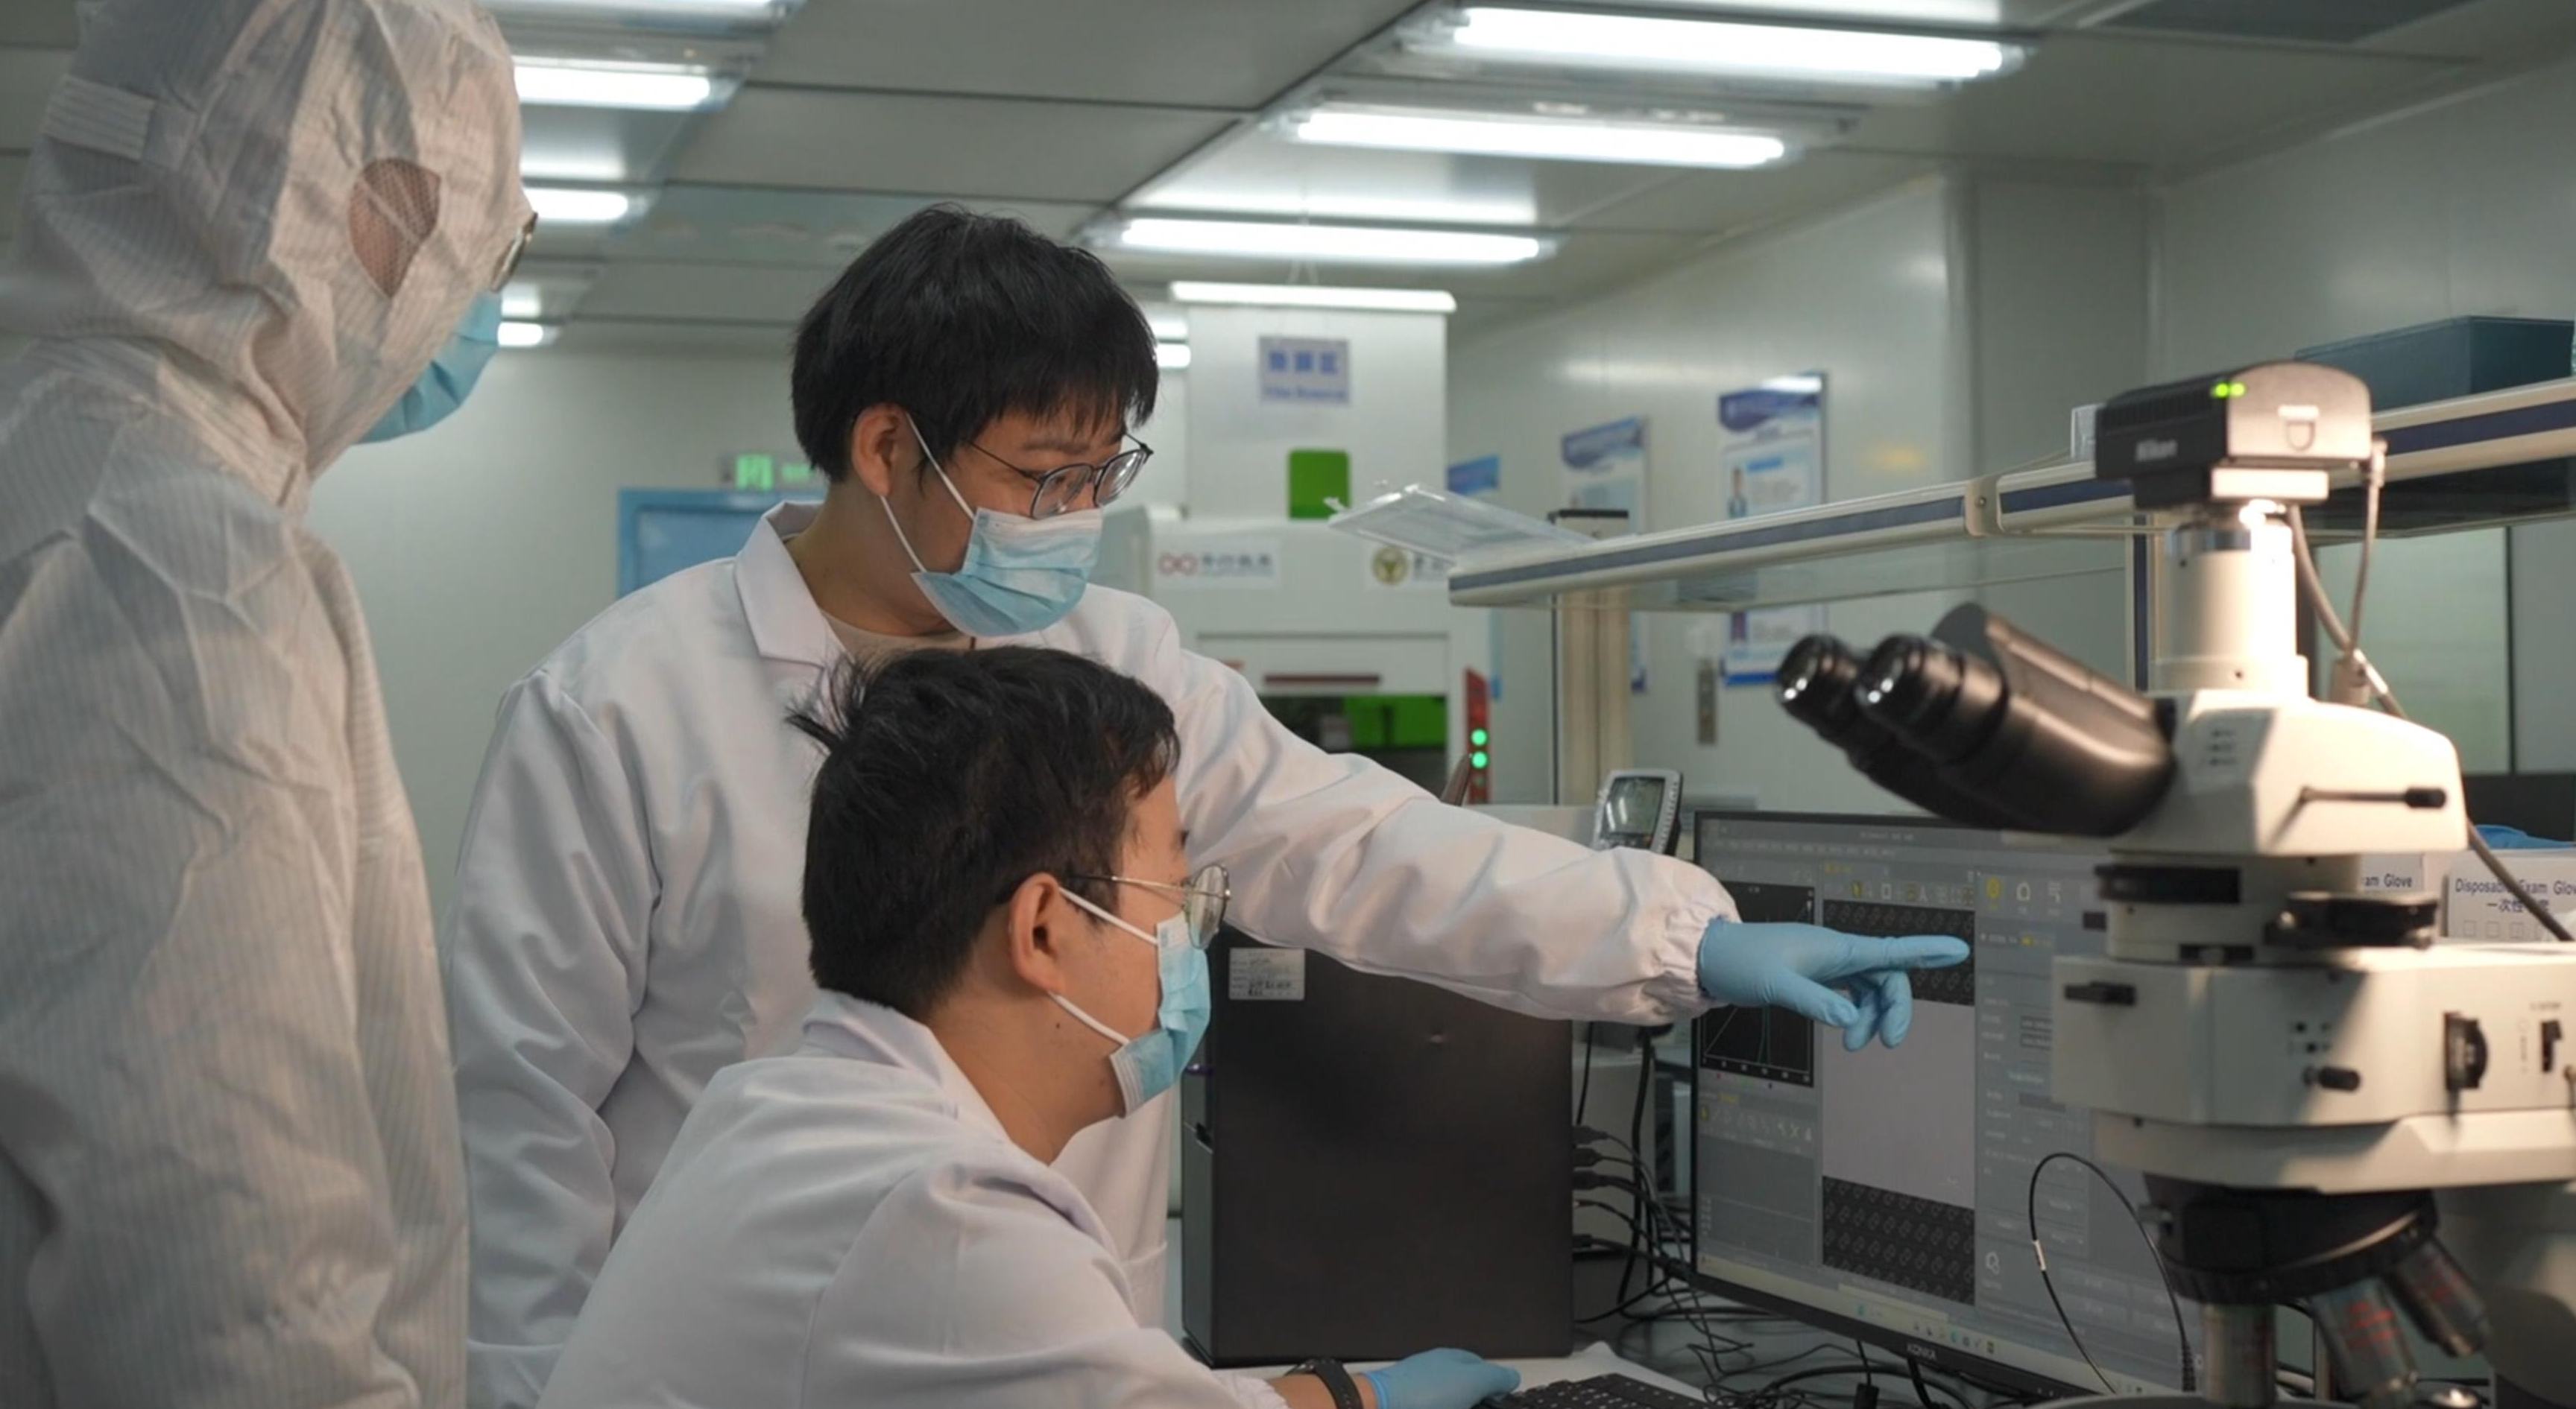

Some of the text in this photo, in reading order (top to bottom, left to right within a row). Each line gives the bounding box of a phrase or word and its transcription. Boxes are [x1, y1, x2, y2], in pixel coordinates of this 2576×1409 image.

[2364, 873, 2413, 887] am Glove
[2455, 878, 2509, 896] Disposab
[2554, 881, 2576, 896] Glov
[2487, 899, 2549, 914] 一次性套
